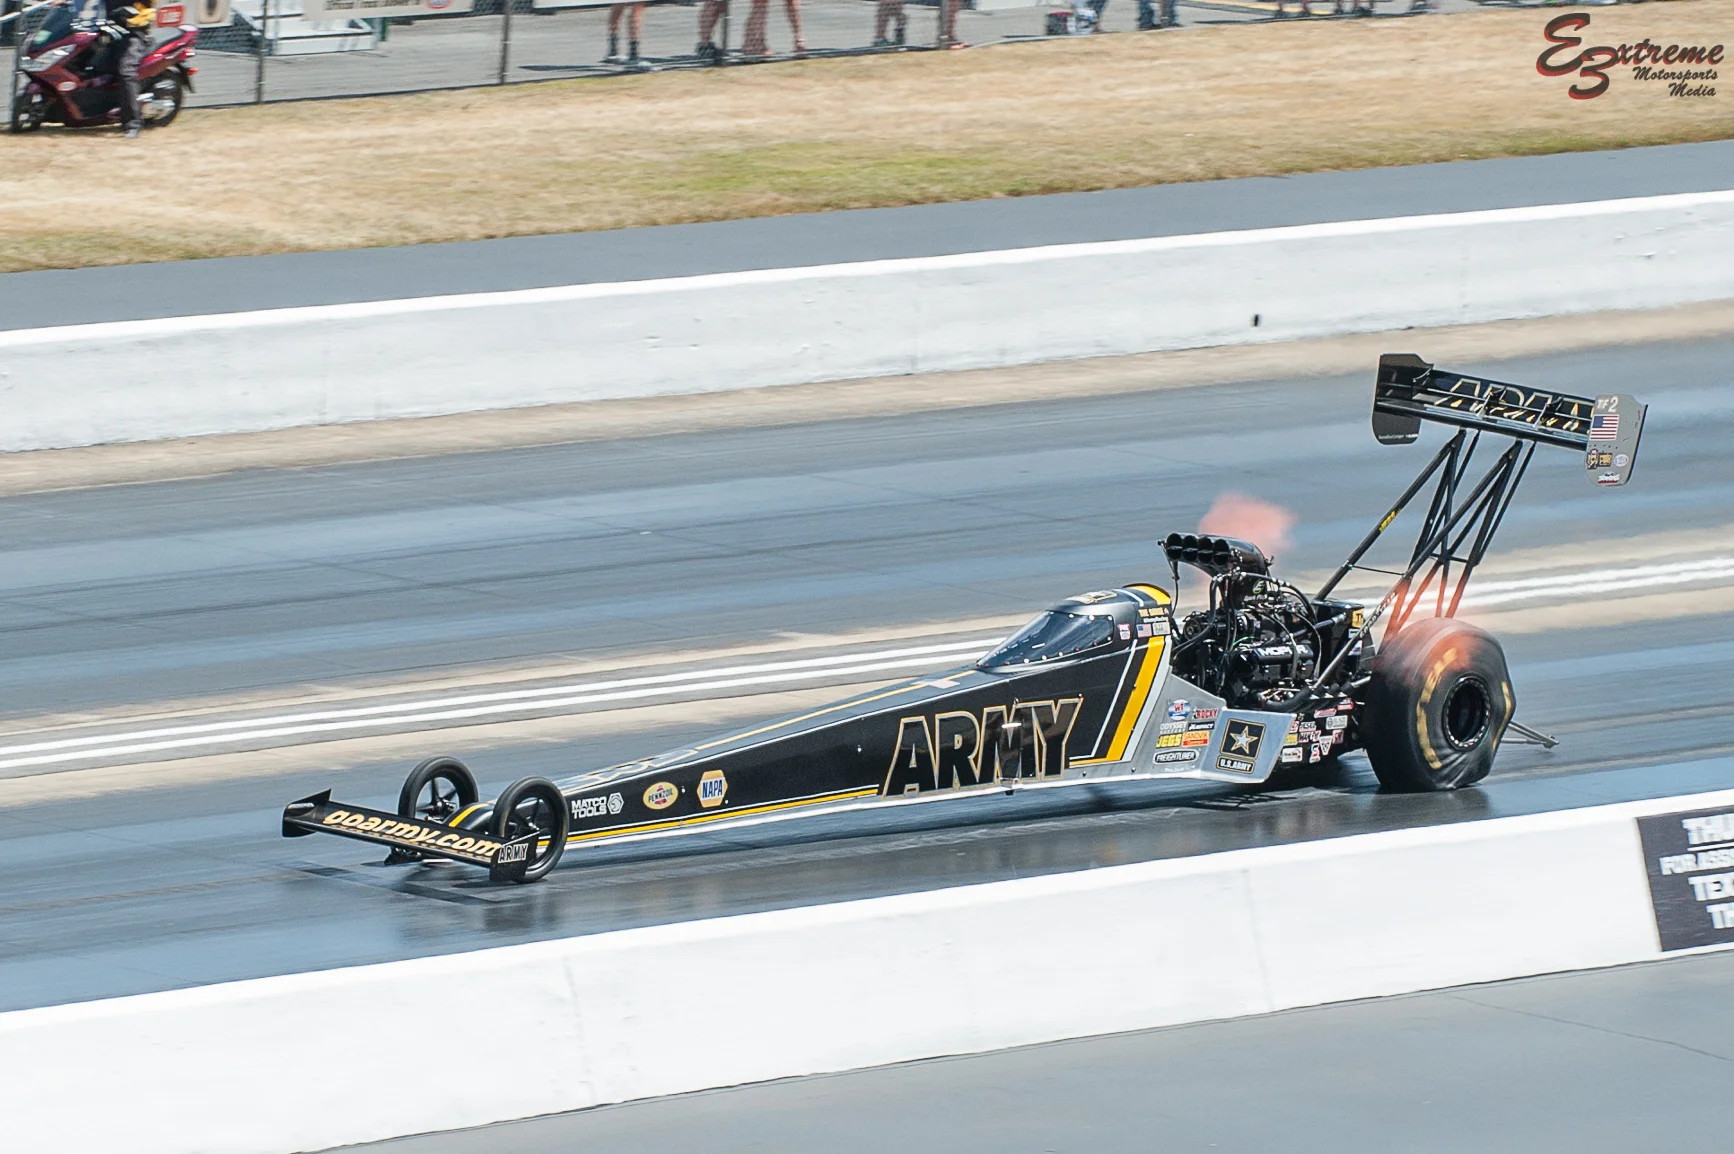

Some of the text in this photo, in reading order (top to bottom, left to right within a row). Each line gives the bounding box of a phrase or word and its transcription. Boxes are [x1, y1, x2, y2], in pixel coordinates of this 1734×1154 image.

[1608, 396, 1619, 413] 2
[881, 697, 1084, 800] ARMY
[648, 792, 674, 803] PENNZOIL
[702, 779, 724, 798] NAPA
[571, 796, 607, 811] MATCO
[572, 804, 607, 819] TOOLS
[322, 809, 502, 857] goarmy.com
[498, 843, 529, 863] ARMY
[1660, 853, 1698, 875] FOR
